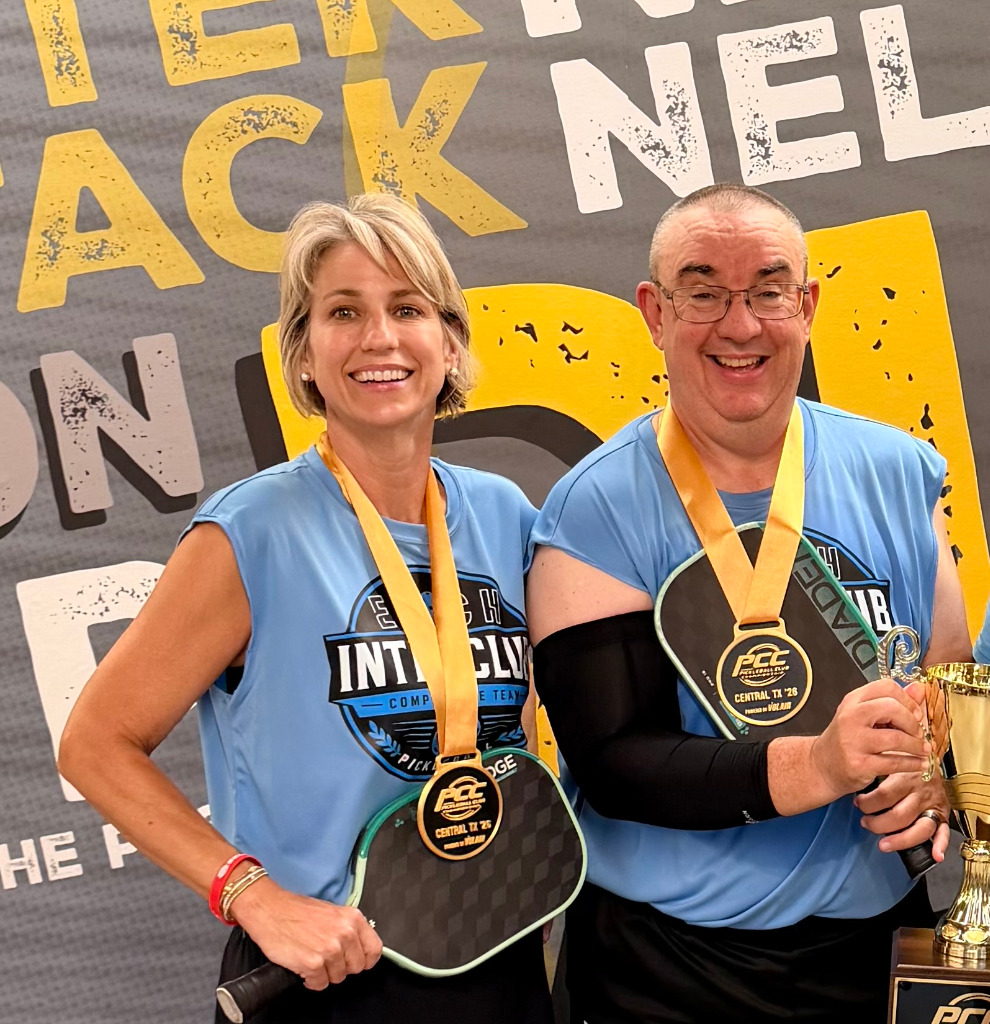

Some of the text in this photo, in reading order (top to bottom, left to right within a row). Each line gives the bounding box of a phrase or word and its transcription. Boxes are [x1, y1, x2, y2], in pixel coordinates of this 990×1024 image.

[0, 62, 529, 313] ACK
[792, 553, 878, 670] DIADE
[732, 650, 790, 678] PCC
[734, 690, 771, 703] CENTRAL
[771, 688, 783, 699] TX
[433, 781, 488, 812] PCC
